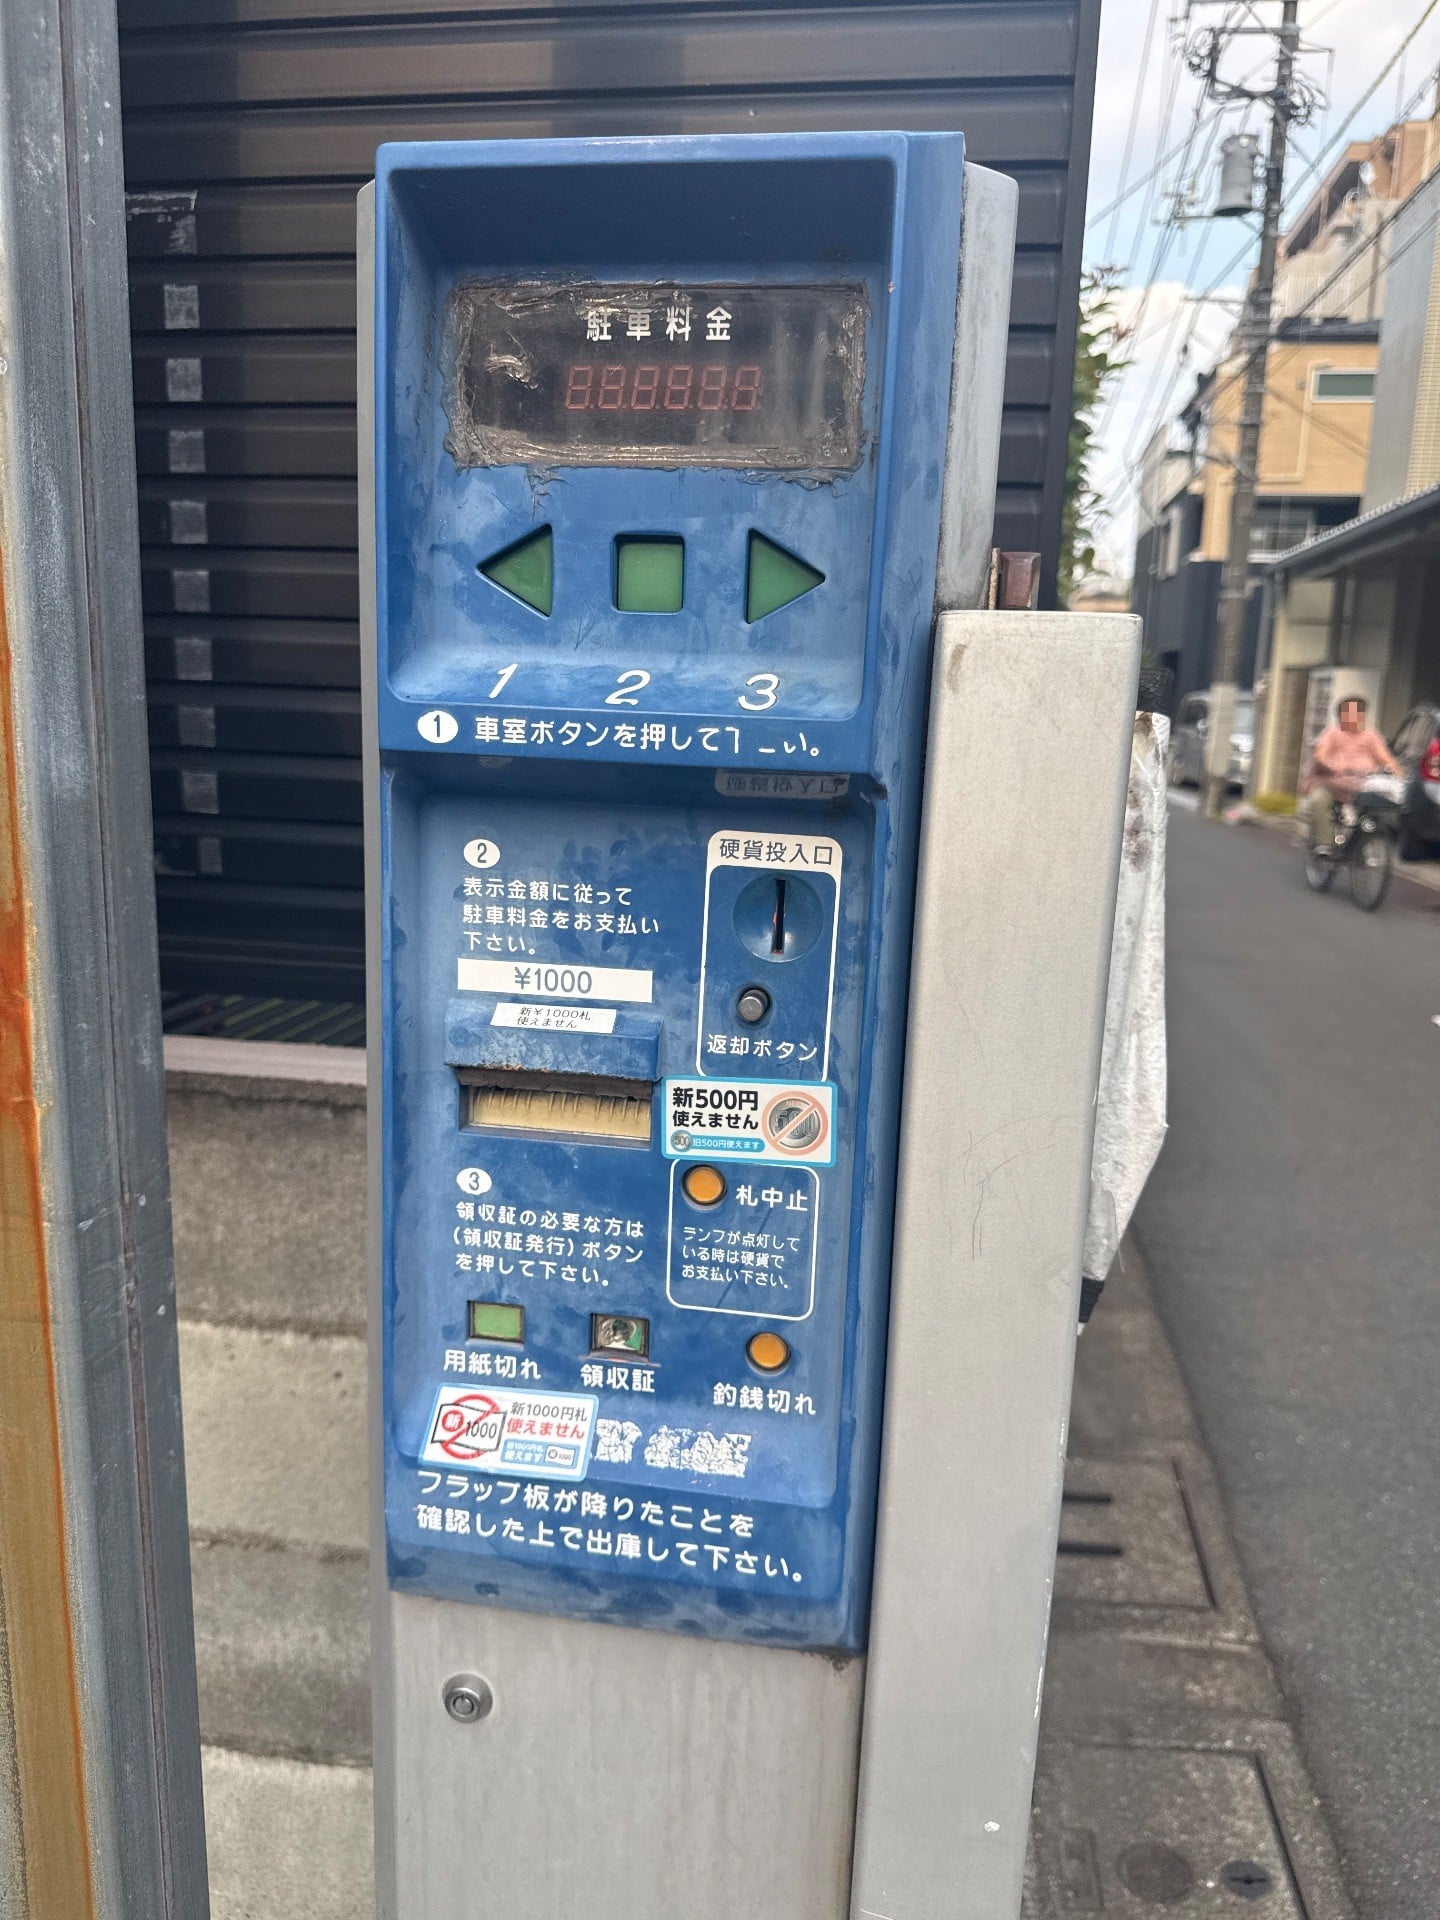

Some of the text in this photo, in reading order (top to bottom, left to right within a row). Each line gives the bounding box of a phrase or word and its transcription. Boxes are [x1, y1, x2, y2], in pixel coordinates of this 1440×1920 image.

[587, 306, 732, 341] 駐車料金
[488, 663, 780, 711] 1 2 3
[720, 838, 833, 866] 硬貨投入口
[463, 877, 632, 906] 表示金額に従って
[463, 904, 660, 935] 駐車料金をお支払い
[463, 931, 536, 955] 下さい。
[514, 966, 593, 994] ¥1000
[517, 1016, 577, 1029] 使えません
[707, 1034, 818, 1061] 返却ボタン
[672, 1087, 759, 1111] 新500円
[672, 1111, 759, 1131] 使えません
[693, 1138, 760, 1150] 旧500円使えます
[736, 1184, 808, 1212] 札中止
[456, 1201, 645, 1238] 領収証の必要な方は
[456, 1252, 609, 1287] を押して下さい。
[682, 1245, 785, 1269] いる時は硬貨で
[681, 1264, 789, 1289] お支払い下さい。
[443, 1349, 542, 1380] 用紙切れ
[580, 1364, 655, 1393] 領収証
[510, 1401, 588, 1422] 新1000円札
[712, 1382, 817, 1415] 釣銭切れ
[465, 1420, 498, 1439] 1000
[507, 1418, 585, 1439] 使えません
[417, 1470, 754, 1538] フラップ板が降りたことを
[416, 1503, 803, 1583] 確認した上で出庫して下さい。
